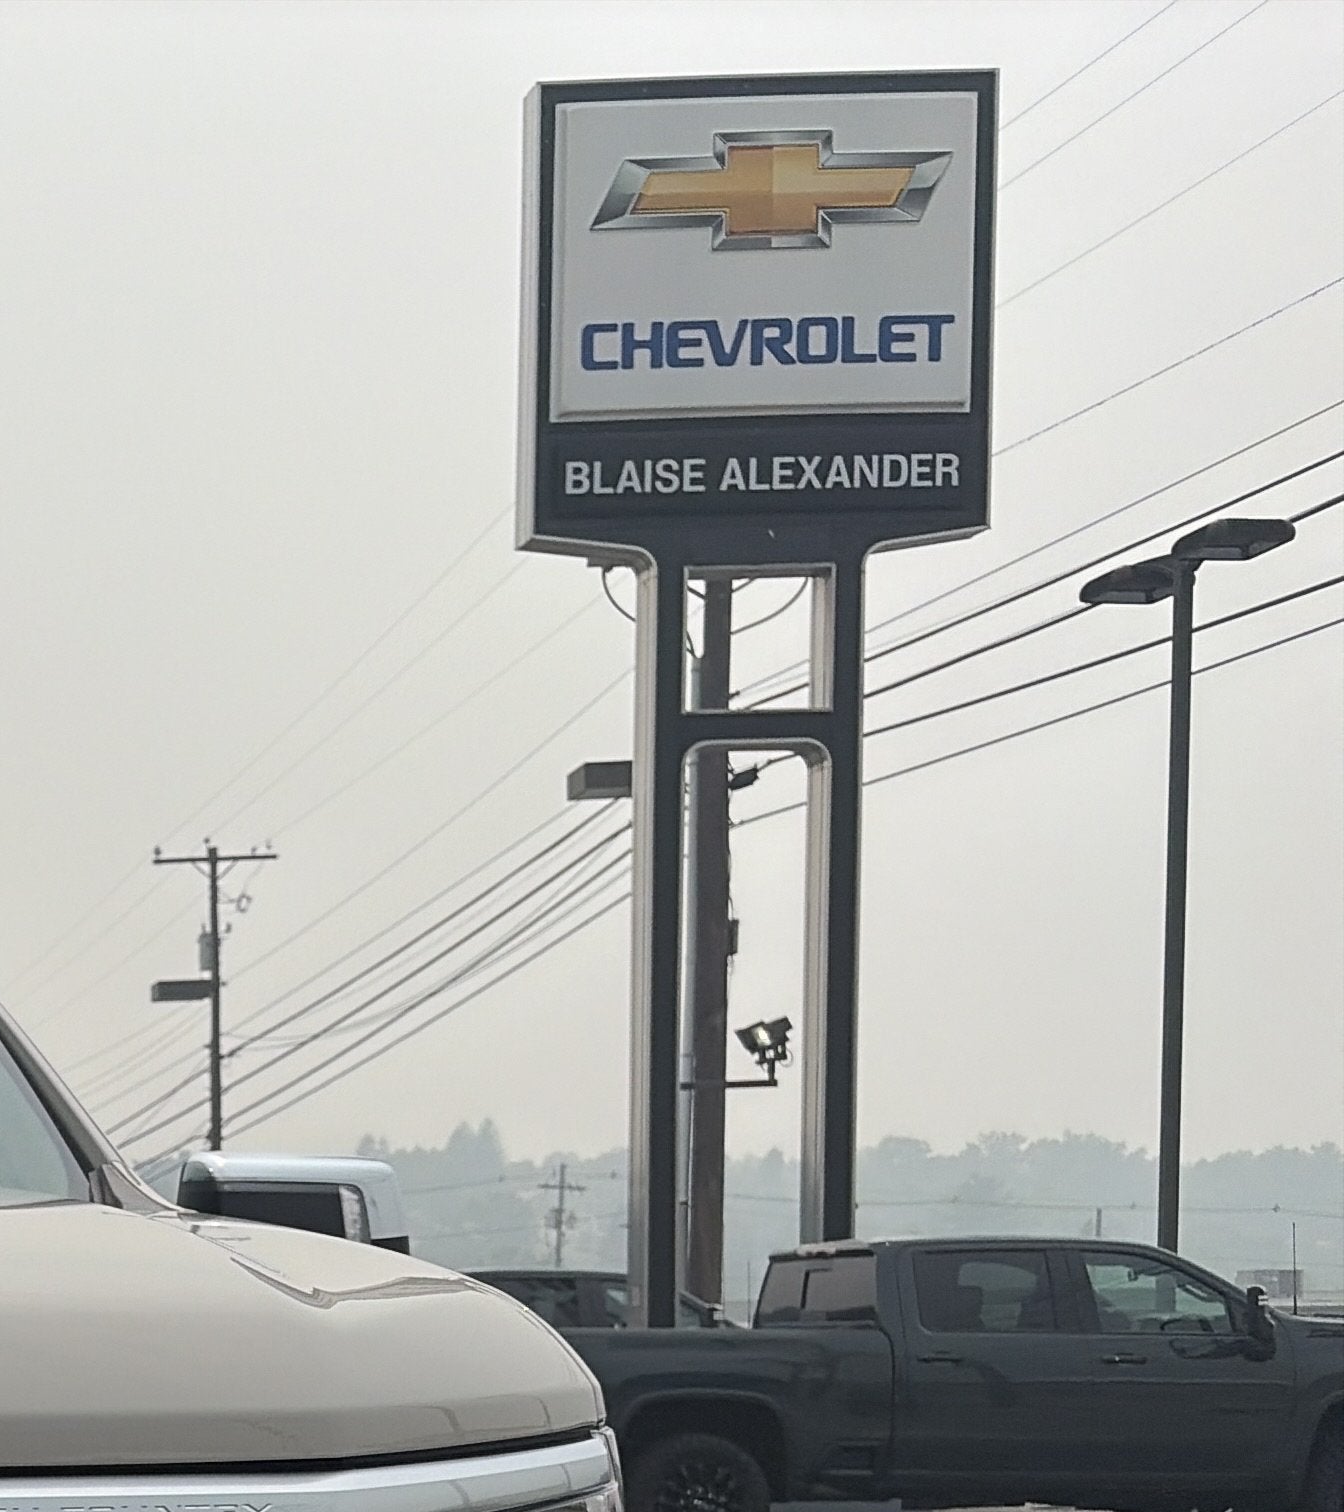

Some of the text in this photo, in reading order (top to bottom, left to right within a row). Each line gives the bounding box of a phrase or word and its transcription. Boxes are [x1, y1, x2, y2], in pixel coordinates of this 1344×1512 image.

[580, 315, 955, 371] CHEVROLET
[565, 453, 960, 495] BLAISE ALEXANDER
